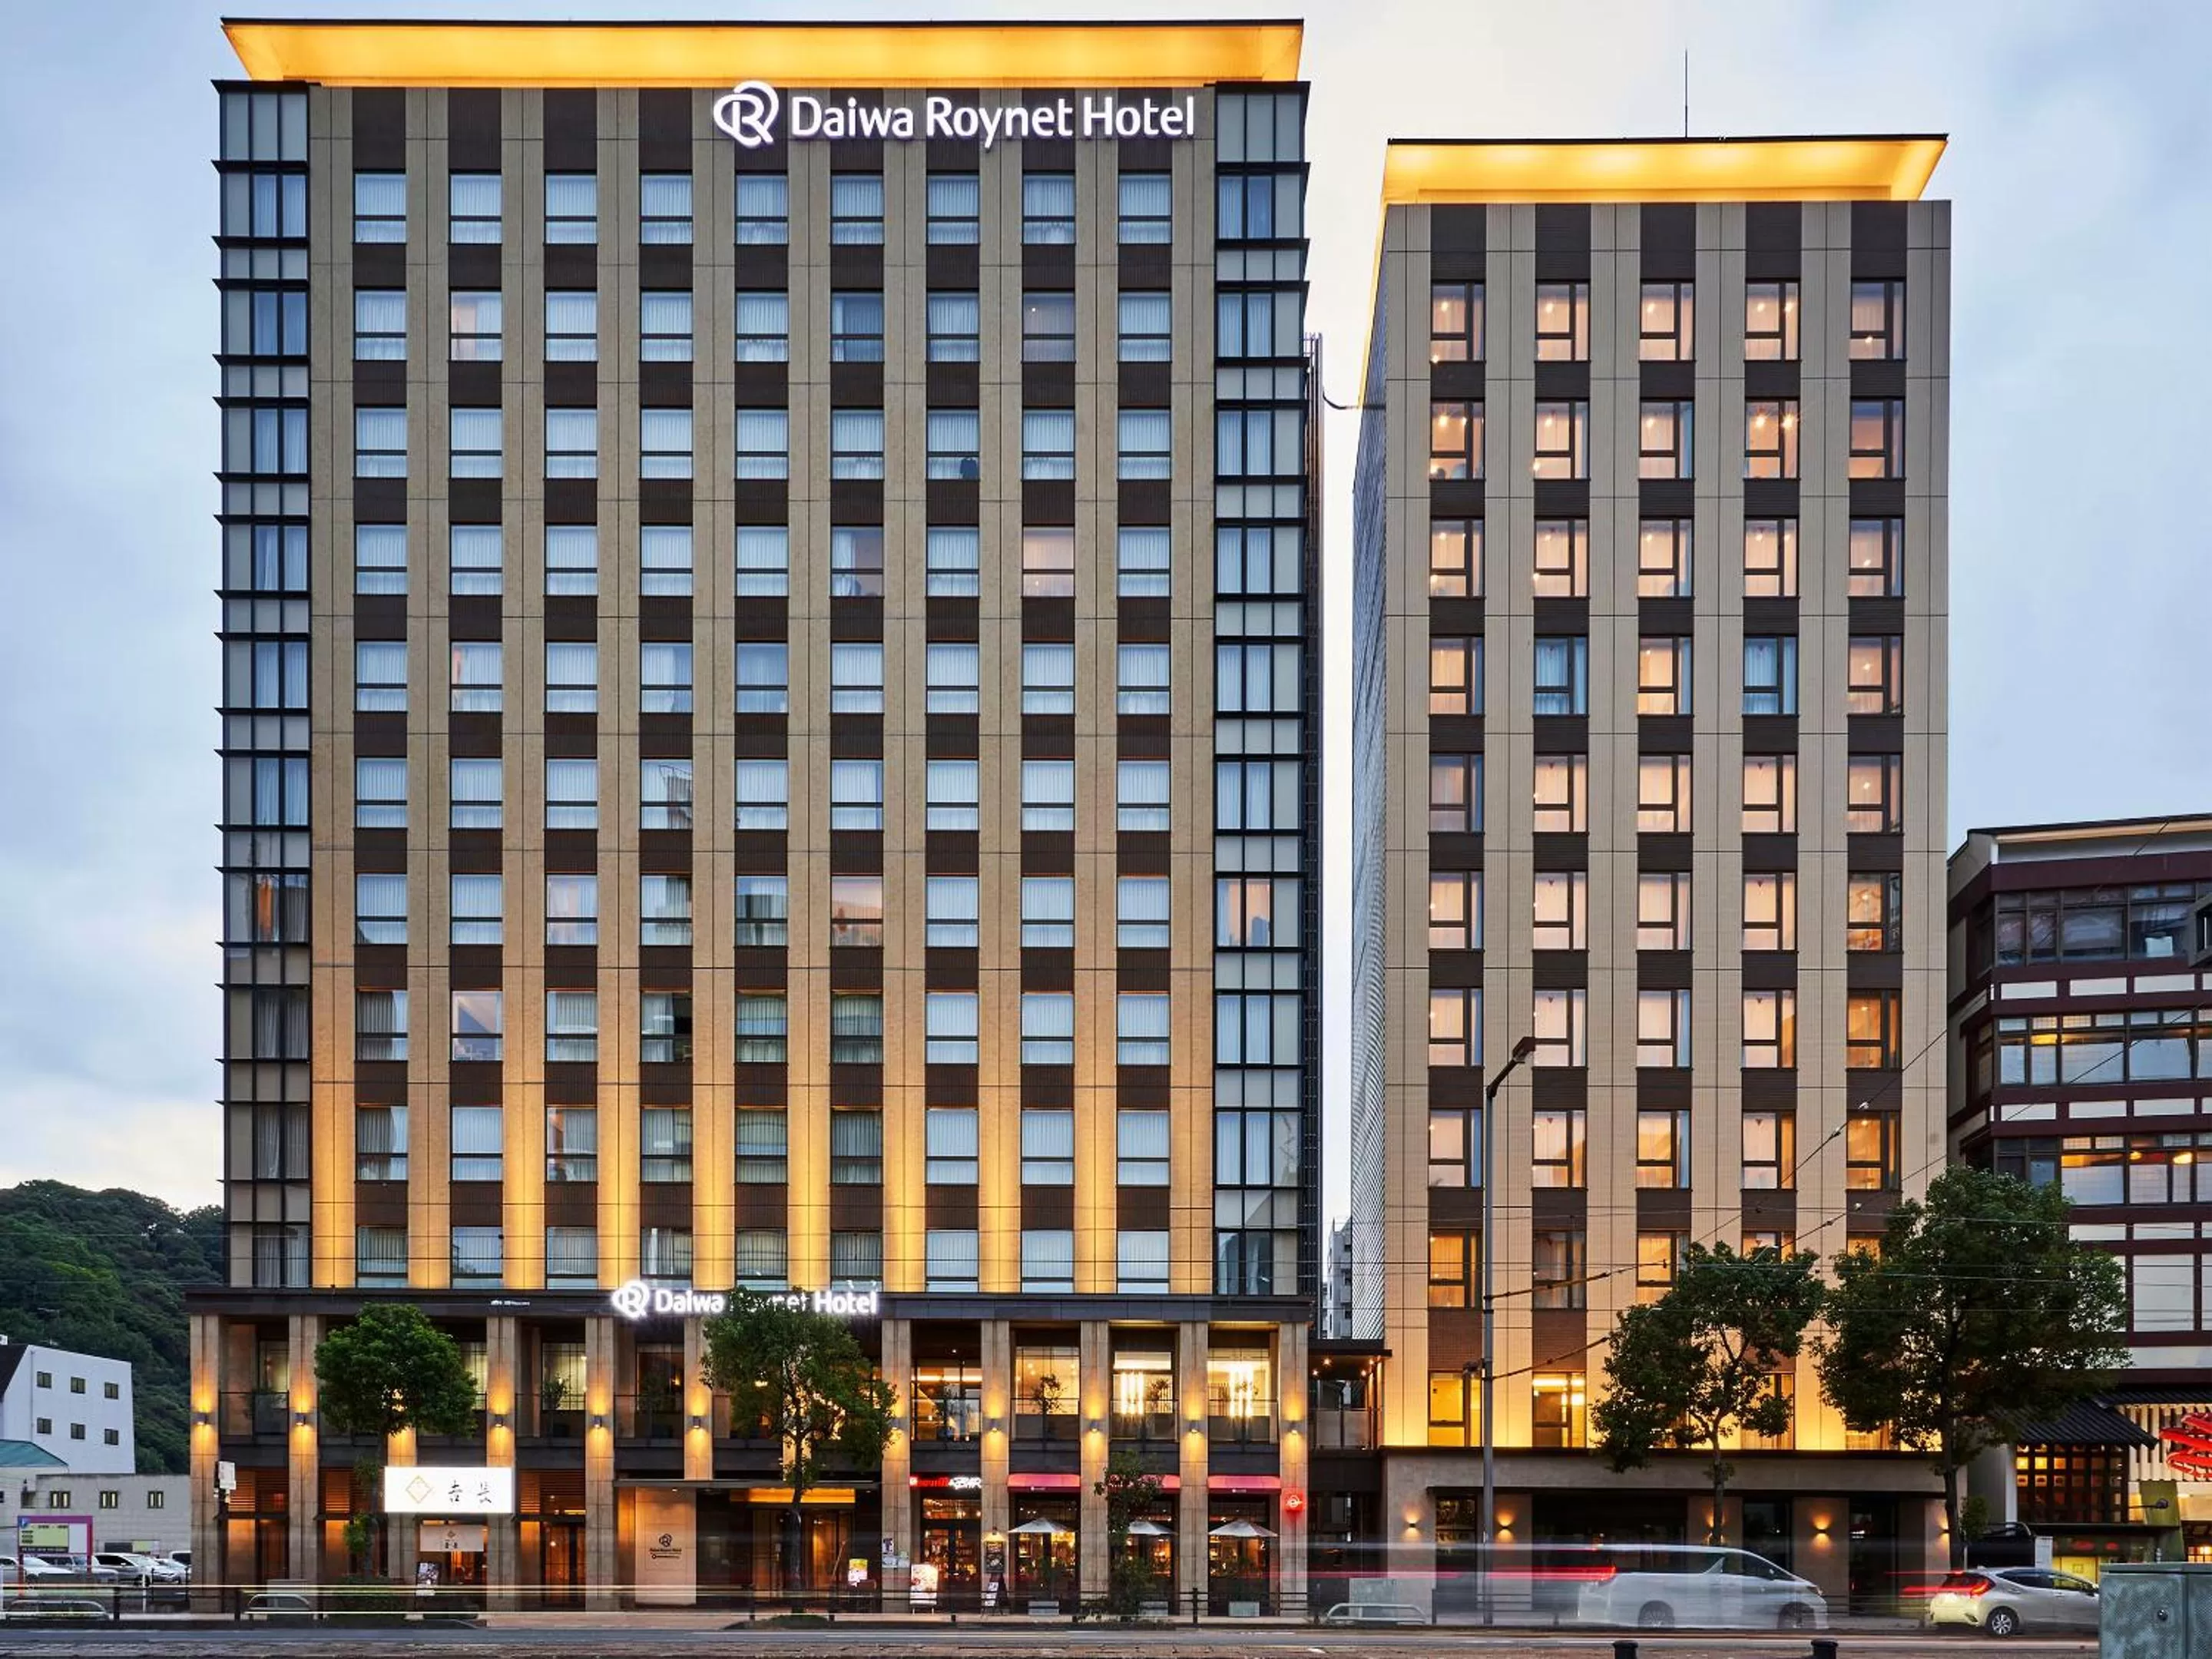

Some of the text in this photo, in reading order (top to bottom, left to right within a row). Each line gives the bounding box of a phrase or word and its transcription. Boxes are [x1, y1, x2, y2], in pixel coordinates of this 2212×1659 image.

[791, 97, 913, 137] Daiwa
[926, 96, 1073, 148] Roynet
[1084, 96, 1194, 137] Hotel
[655, 1290, 725, 1313] Daiwa
[730, 1291, 810, 1313] ynet
[814, 1289, 879, 1314] Hotel
